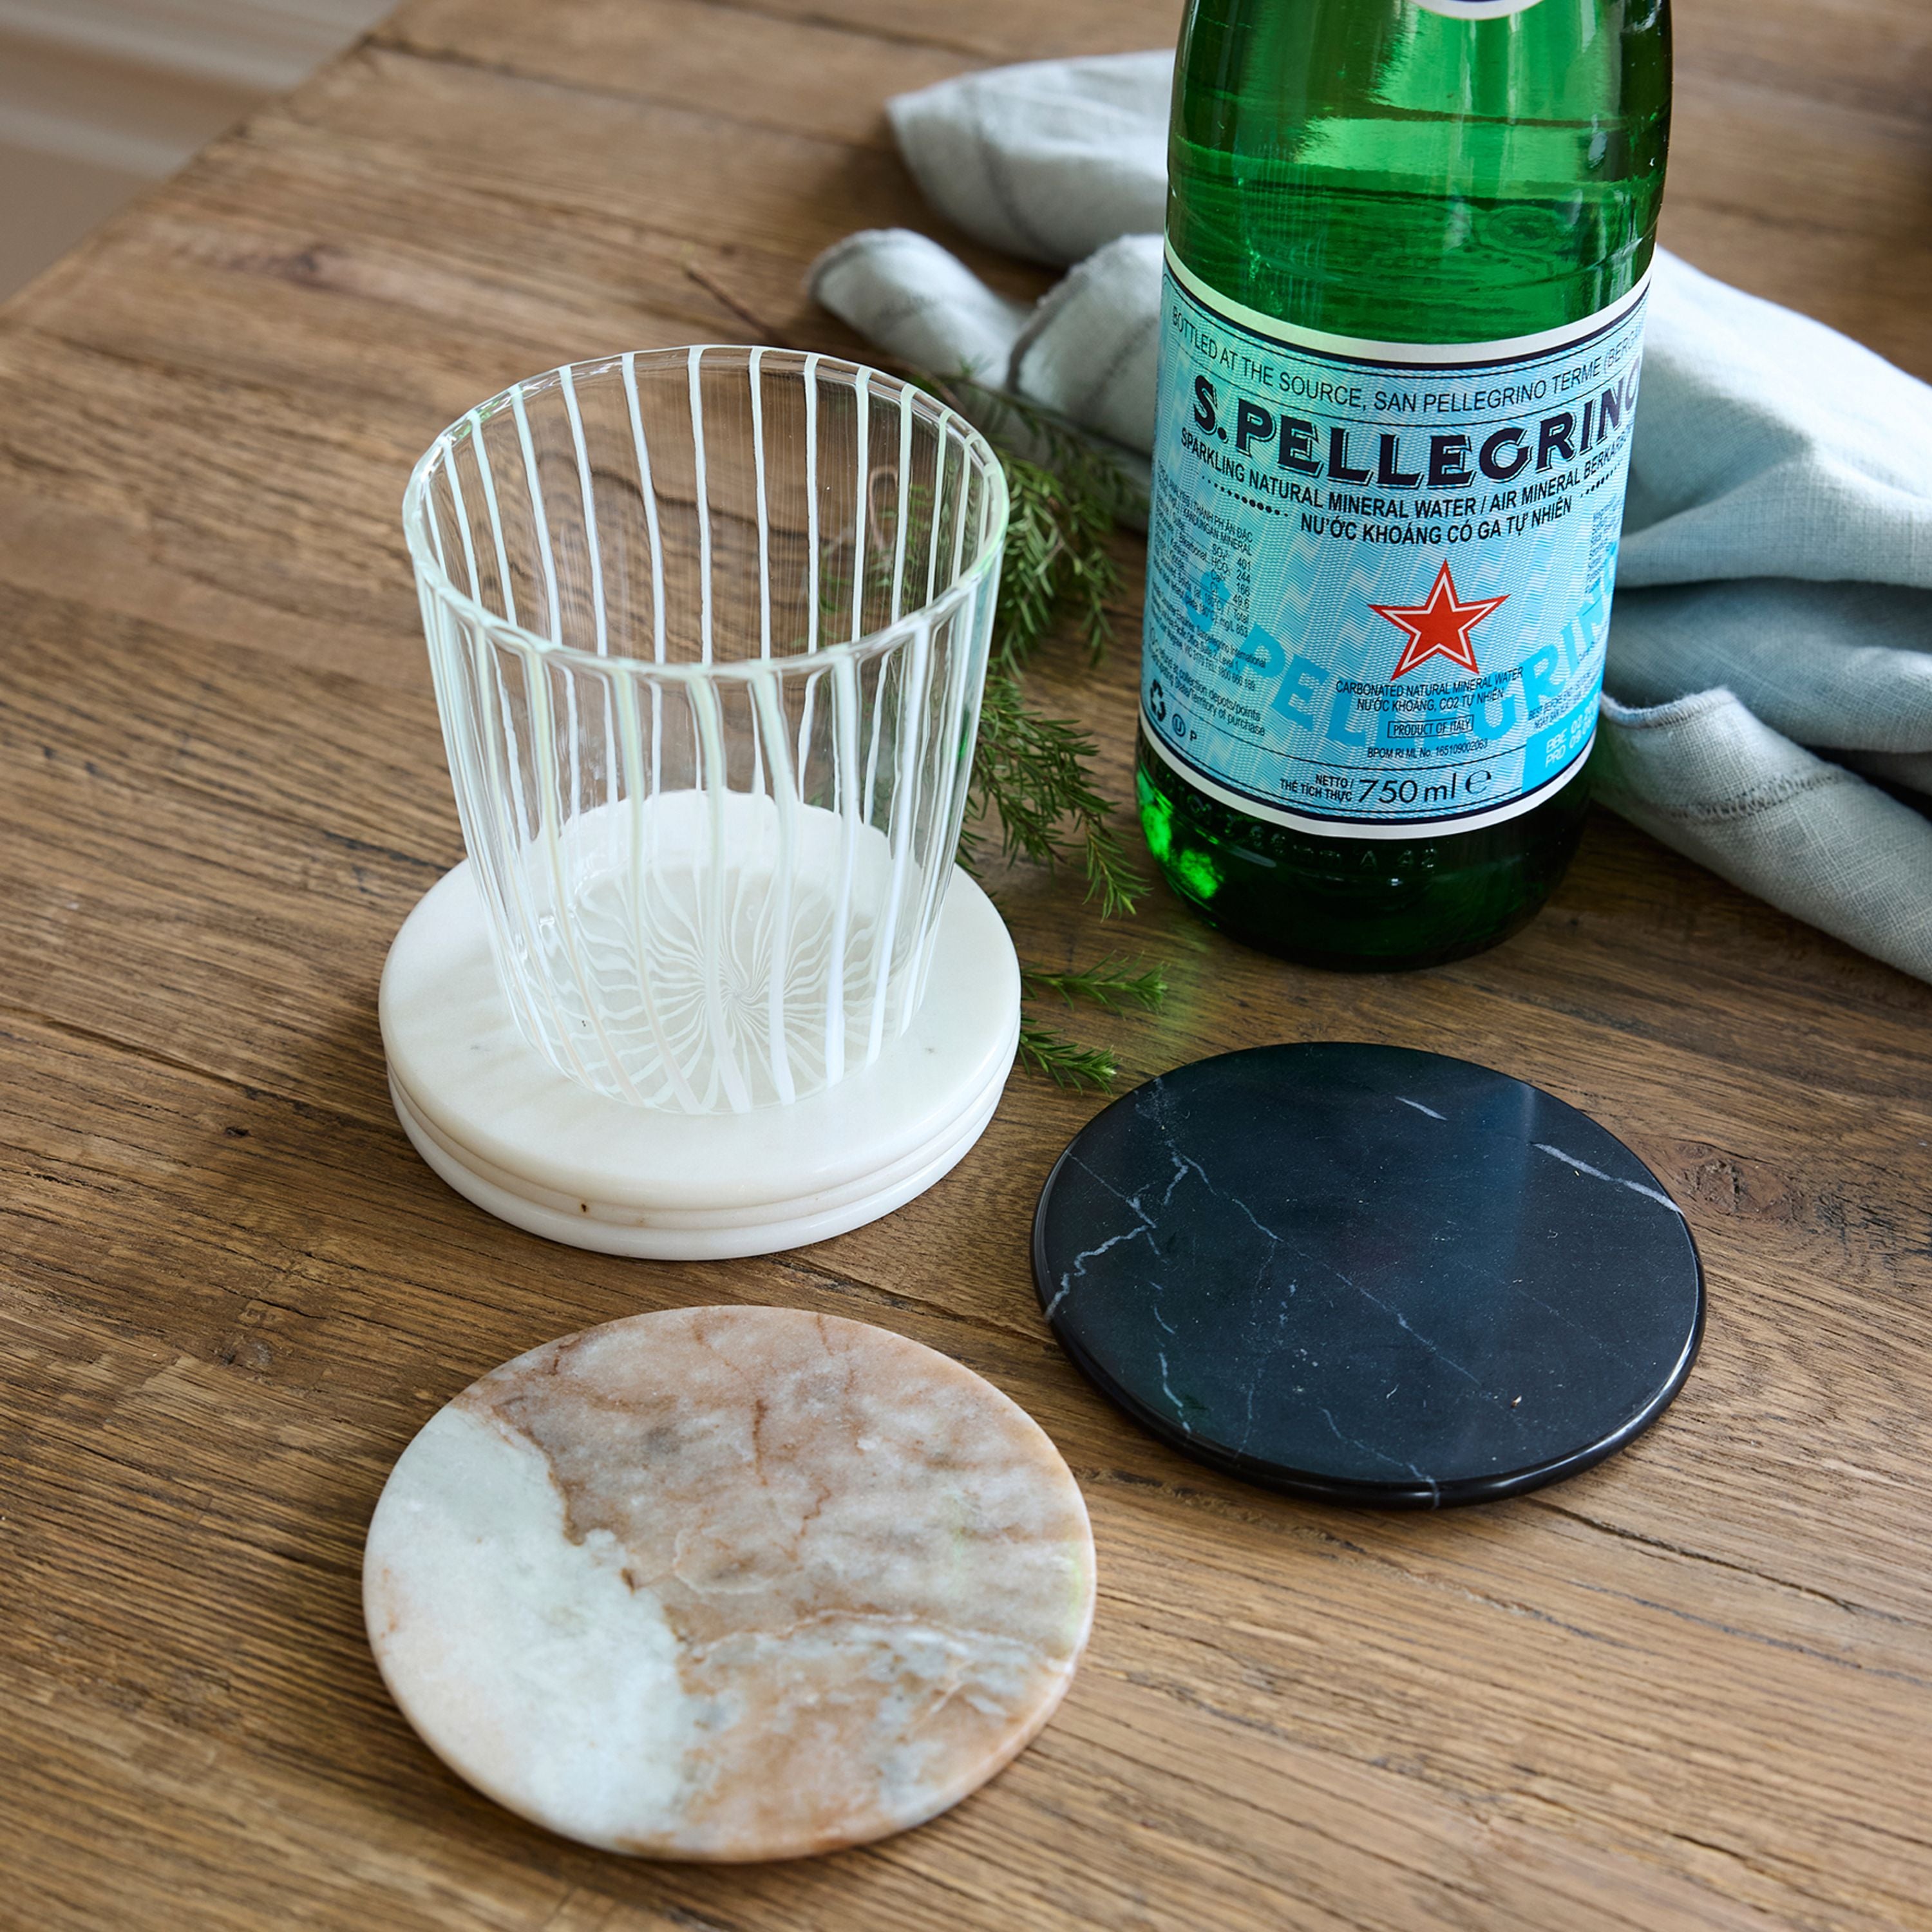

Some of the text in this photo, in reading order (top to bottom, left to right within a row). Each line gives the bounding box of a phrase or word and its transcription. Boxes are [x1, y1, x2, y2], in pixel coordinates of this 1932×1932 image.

[1172, 305, 1218, 359] BOTTLED
[1220, 348, 1238, 371] AT
[1242, 357, 1275, 387] THE
[1279, 372, 1367, 412] SOURCE,
[1374, 391, 1416, 413] SAN
[1423, 379, 1547, 413] PELLEGRINO
[1551, 356, 1602, 394] TERME
[1181, 426, 1245, 484] SPARKLING
[1249, 468, 1323, 509] NATURAL
[1328, 491, 1410, 518] MINERAL
[1414, 497, 1476, 518] WATER
[1481, 495, 1487, 515] /
[1489, 490, 1518, 513] AIR
[1521, 467, 1580, 506] MINERAL
[1362, 522, 1442, 545] KHOÁNG
[1447, 519, 1473, 544] CÓ
[1477, 520, 1502, 540] GA
[1531, 495, 1573, 529] NHIÊN
[1335, 666, 1524, 697] CARBONATED NATURAL MINERAL WATER
[1439, 697, 1459, 710] CO2
[1227, 712, 1265, 737] purchase
[1392, 718, 1472, 737] PRODUCT OF ITALY
[1367, 746, 1394, 759] BPOM
[1546, 728, 1568, 753] BBE
[1545, 744, 1566, 768] PRD
[1358, 778, 1418, 804] 750
[1423, 772, 1458, 802] ml
